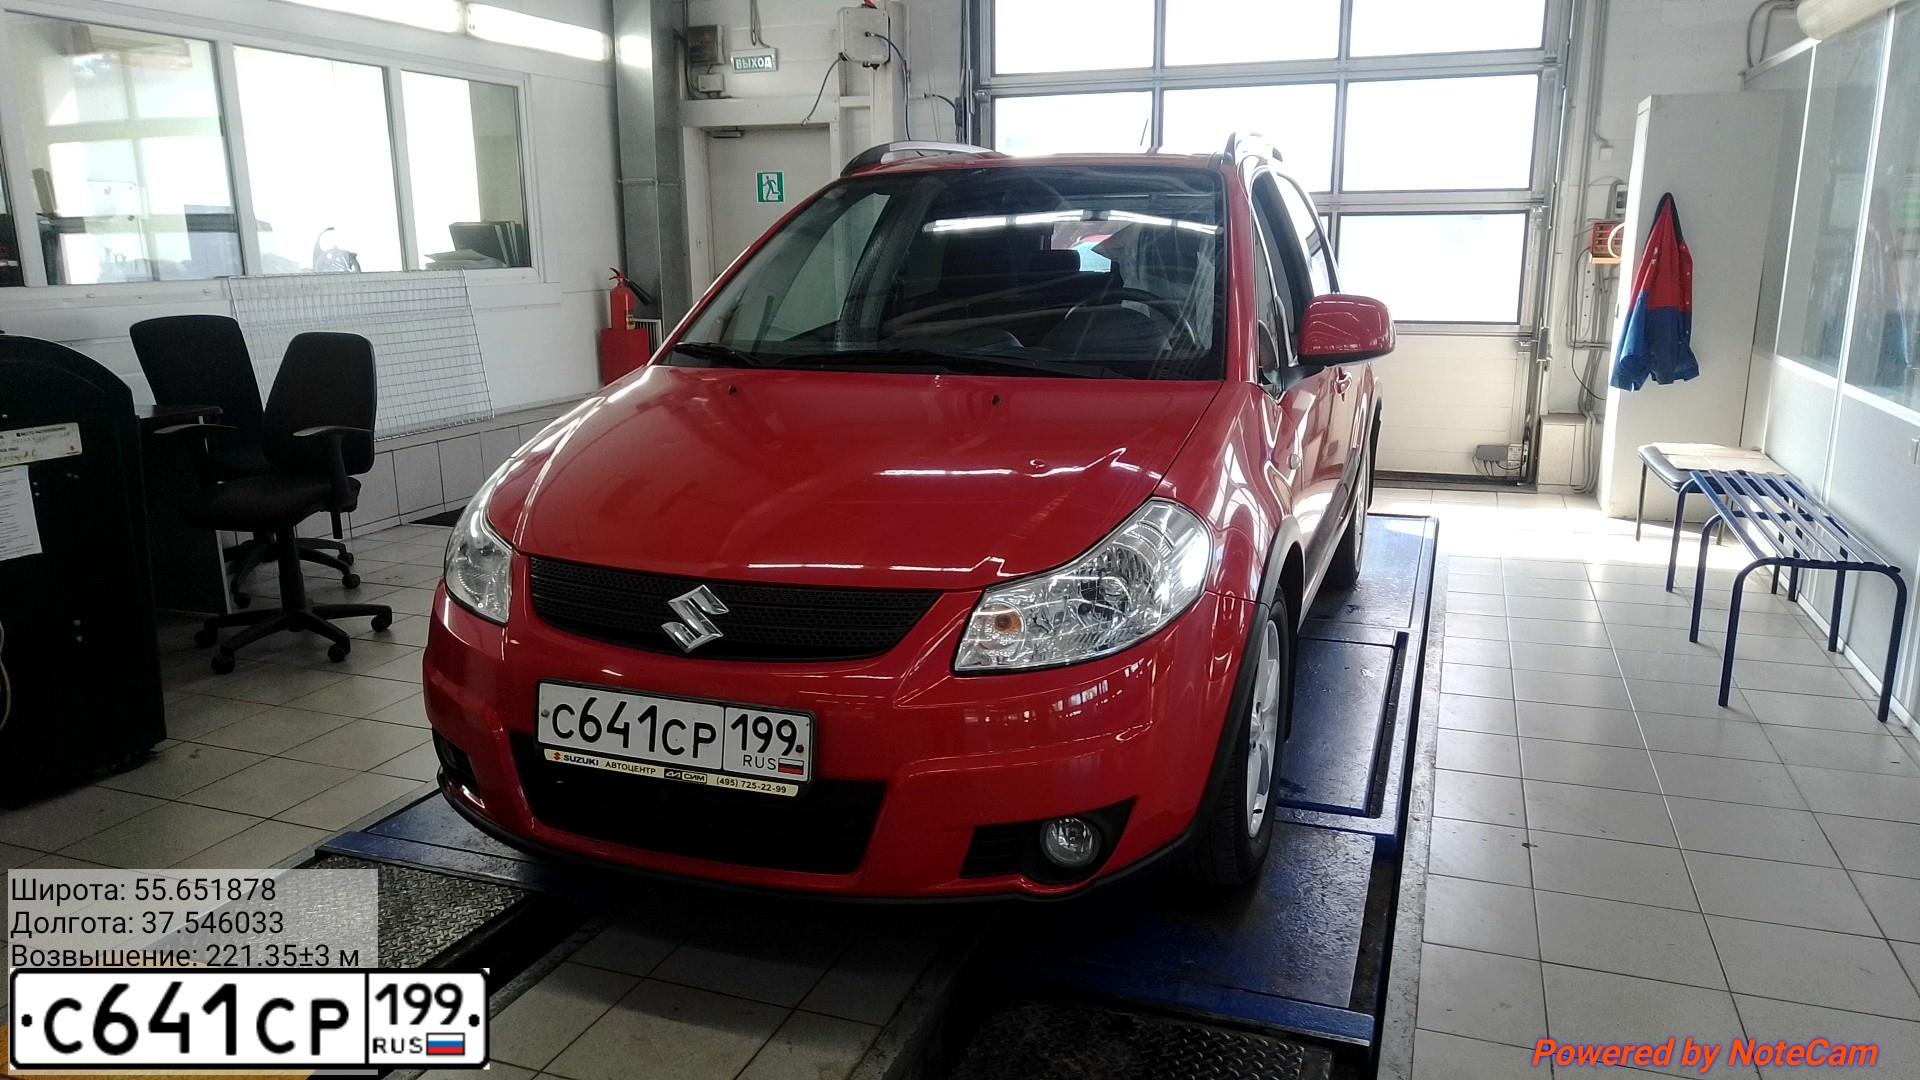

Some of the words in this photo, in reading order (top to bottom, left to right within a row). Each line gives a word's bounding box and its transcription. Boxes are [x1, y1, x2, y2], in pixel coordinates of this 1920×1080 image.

[735, 55, 773, 70] ВЫХОД
[730, 713, 798, 757] 199
[563, 754, 599, 767] SUZUKI
[605, 761, 656, 775] АВТОЦЕНТР
[716, 776, 739, 788] (495)
[741, 780, 787, 794] 725-22-99
[742, 754, 777, 771] RUS
